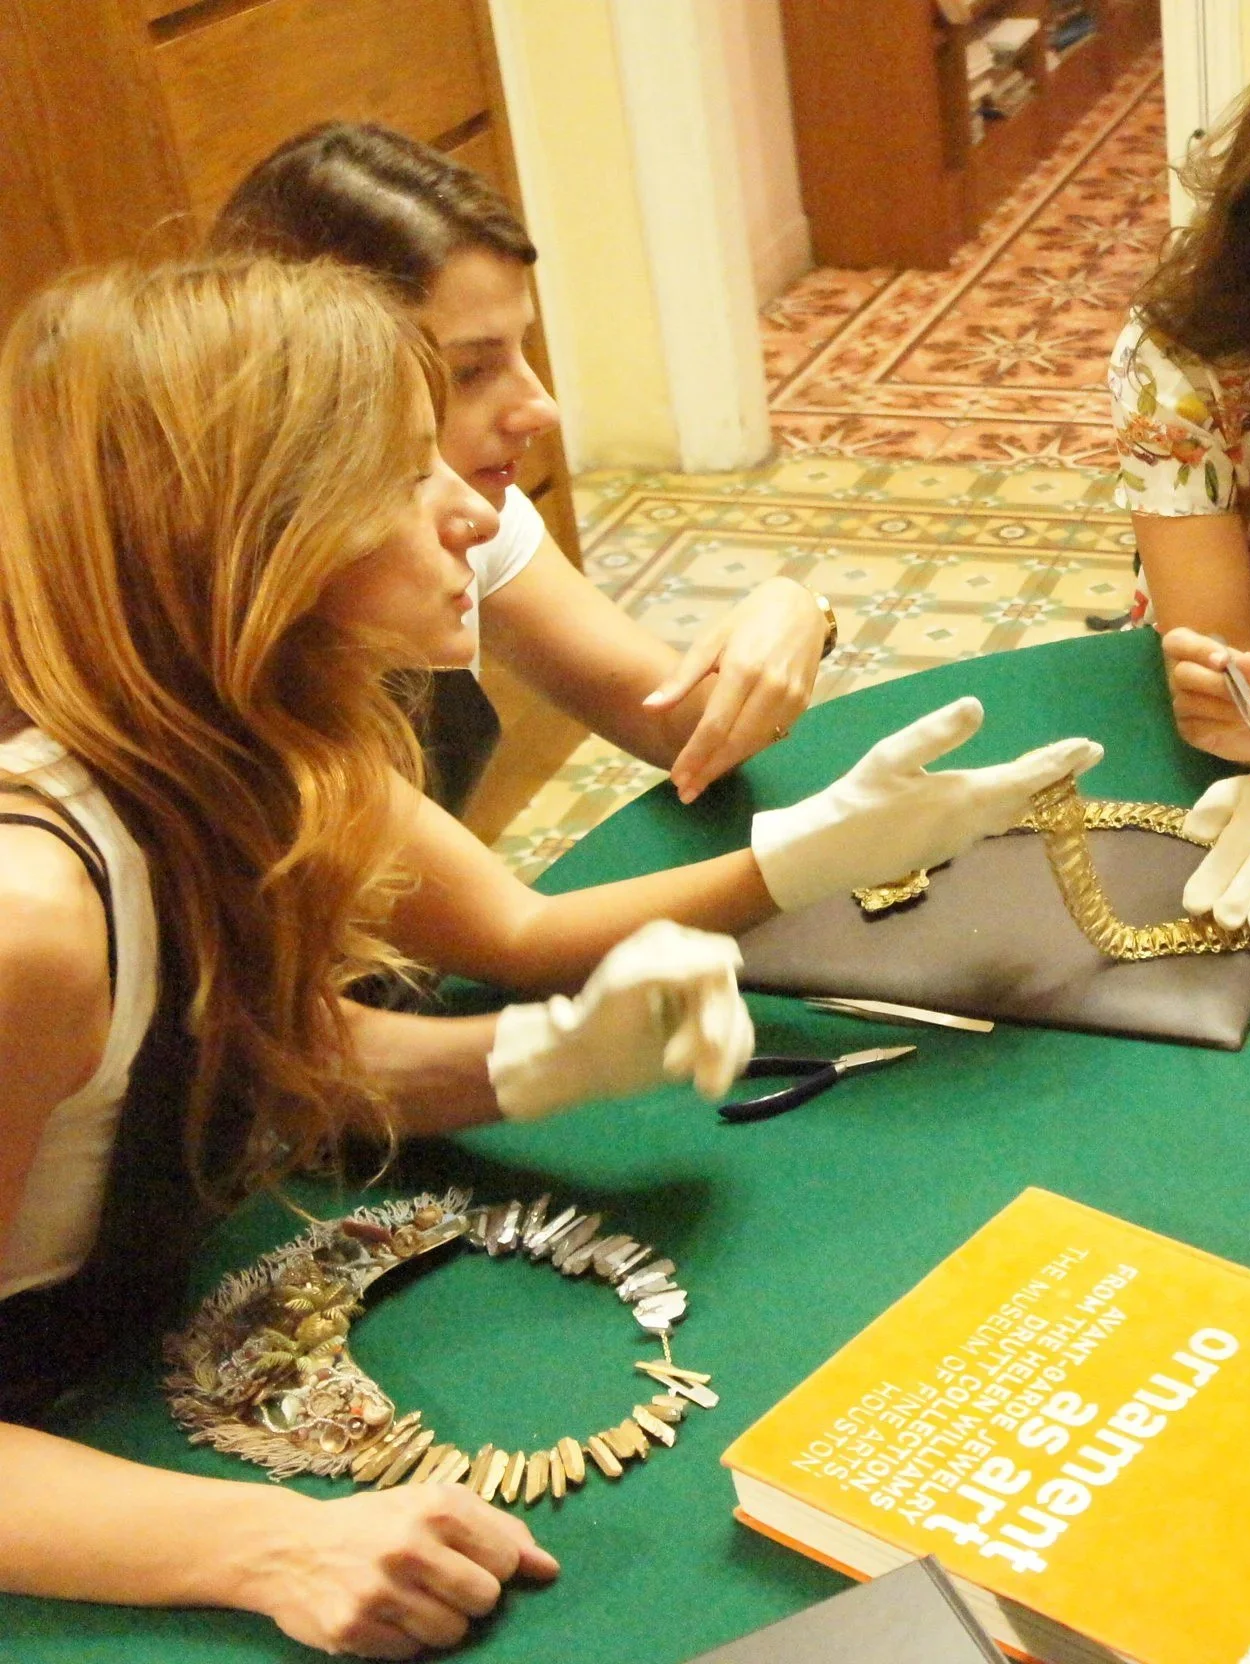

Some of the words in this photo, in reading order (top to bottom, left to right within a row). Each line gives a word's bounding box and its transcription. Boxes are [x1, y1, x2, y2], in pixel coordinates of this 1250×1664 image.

[1041, 1248, 1088, 1280] THE
[1076, 1263, 1139, 1314] FROM
[962, 1280, 1050, 1354] MUSEUM
[977, 1314, 1050, 1376] DRUTT
[1037, 1315, 1087, 1352] THE
[937, 1356, 966, 1383] OF
[971, 1350, 1047, 1413] HELEN
[990, 1306, 1127, 1431] AVANT-GARDE
[792, 1382, 901, 1471] HOUSTON
[840, 1374, 982, 1492] COLLECTION,
[878, 1383, 938, 1429] FINE
[1017, 1391, 1099, 1455] as
[814, 1426, 885, 1480] ARTS,
[869, 1414, 983, 1511] WILLIAMS
[897, 1428, 997, 1526] JEWELRY
[978, 1327, 1240, 1575] ornament
[913, 1453, 1032, 1547] art
